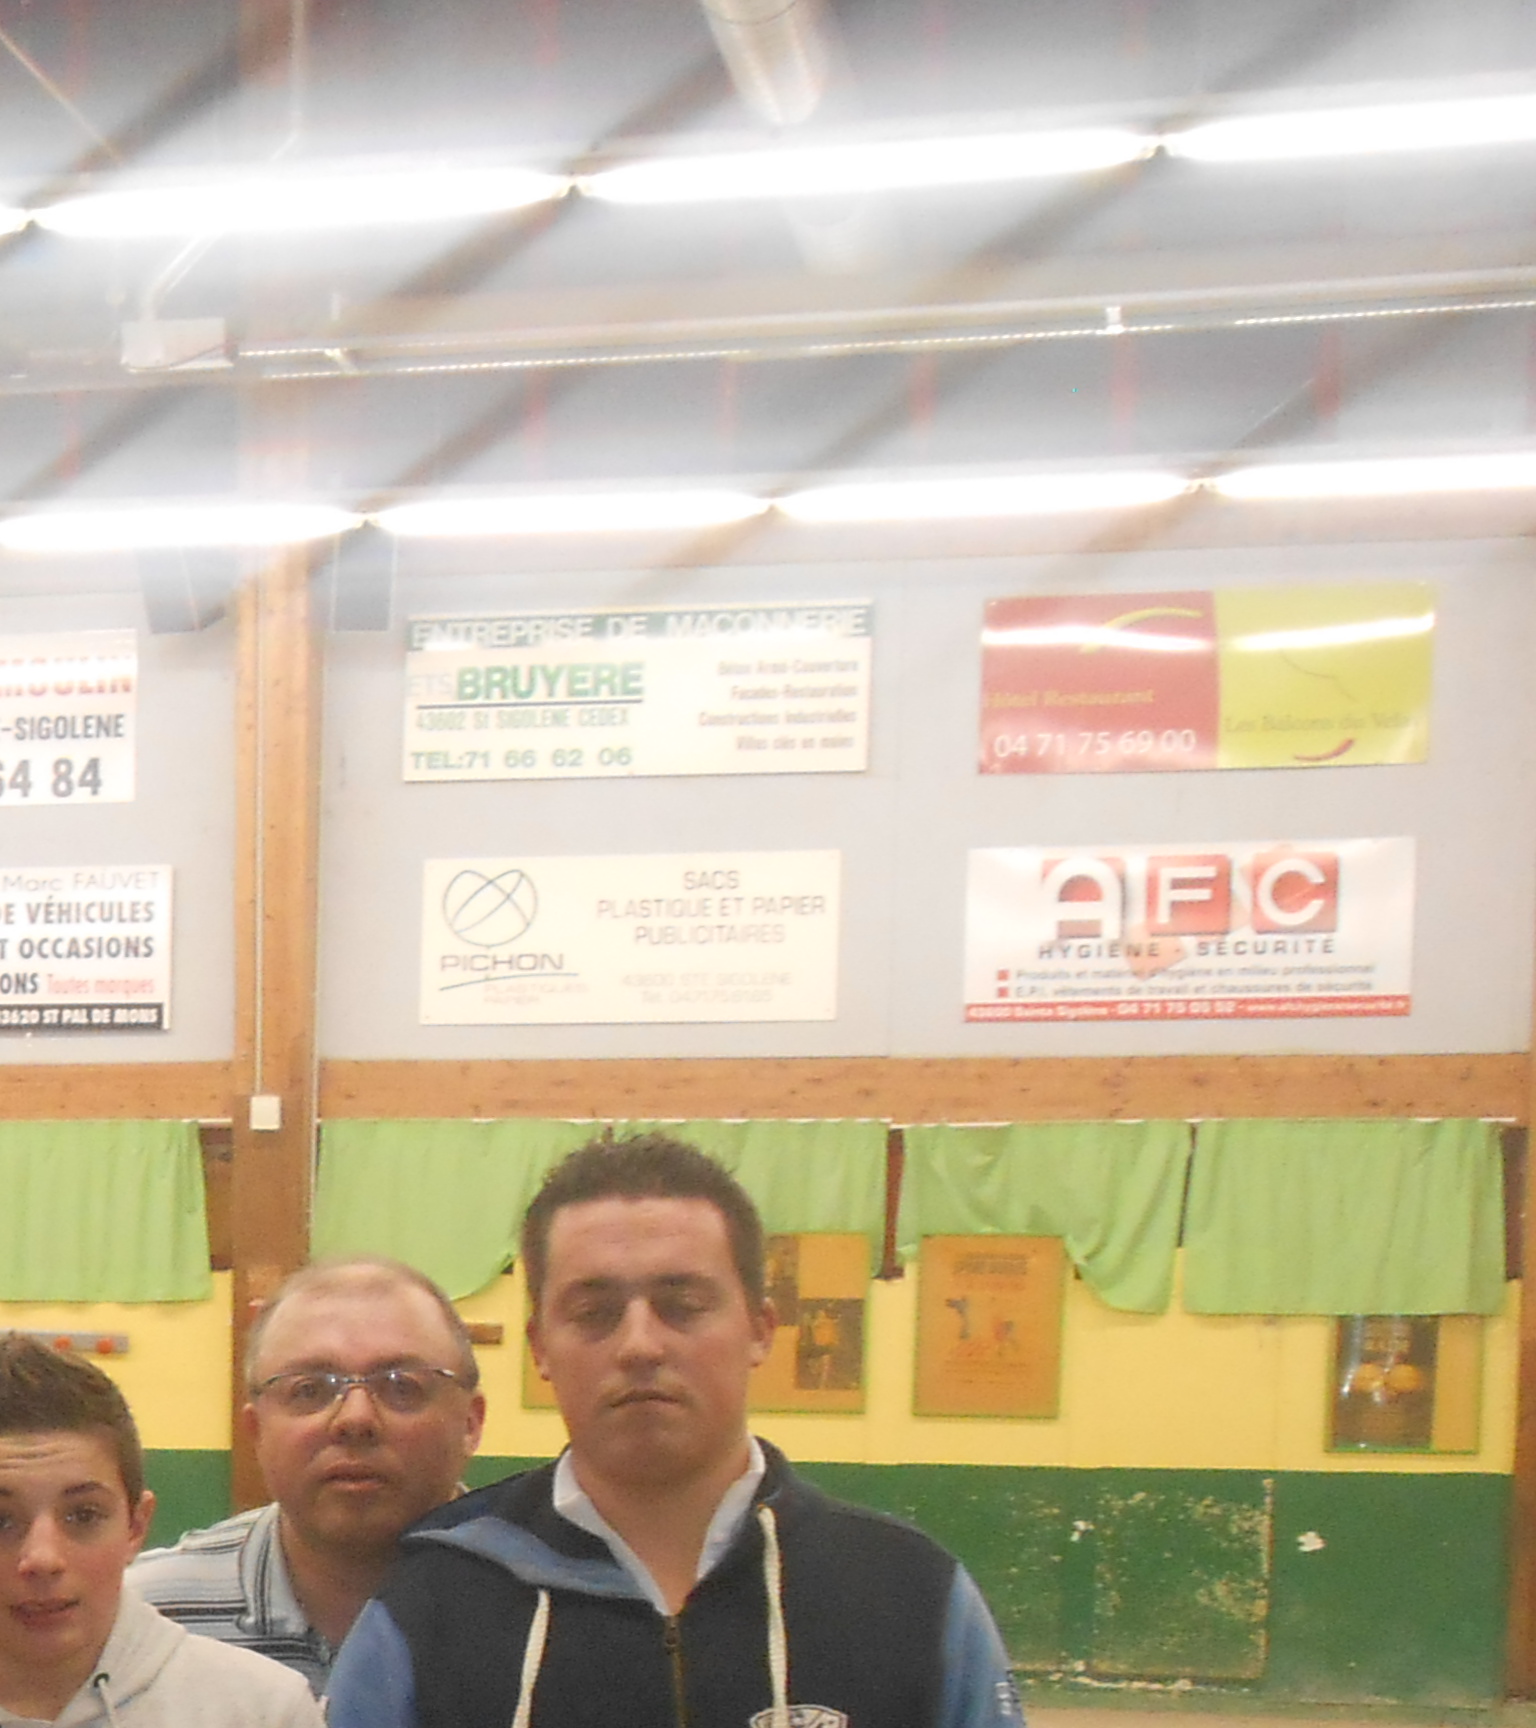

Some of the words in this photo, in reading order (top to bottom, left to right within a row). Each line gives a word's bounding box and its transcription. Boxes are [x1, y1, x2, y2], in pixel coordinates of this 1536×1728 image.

[605, 616, 648, 638] DE
[456, 662, 644, 700] BRUYERE
[994, 735, 1028, 757] 04
[1037, 734, 1066, 756] 71
[1079, 732, 1111, 755] 75
[1118, 731, 1154, 754] 69
[1163, 730, 1196, 752] 00
[504, 750, 536, 769] 66
[551, 748, 584, 767] 62
[598, 747, 633, 766] 06
[51, 758, 102, 798] 84
[1, 875, 63, 894] Marc
[72, 871, 160, 890] FAUVET
[684, 870, 740, 890] SACS
[597, 898, 713, 919] PLASTIQUE
[720, 898, 744, 916] ET
[752, 895, 826, 916] PAPIER
[1042, 857, 1326, 939] AFC
[27, 896, 155, 924] VÉHICULES
[635, 924, 785, 945] PUBLICITAIRES
[19, 936, 154, 959] OCCASIONS
[440, 954, 564, 972] PICHON
[43, 1008, 58, 1024] ST
[61, 1008, 87, 1024] PAL
[91, 1008, 111, 1024] DE
